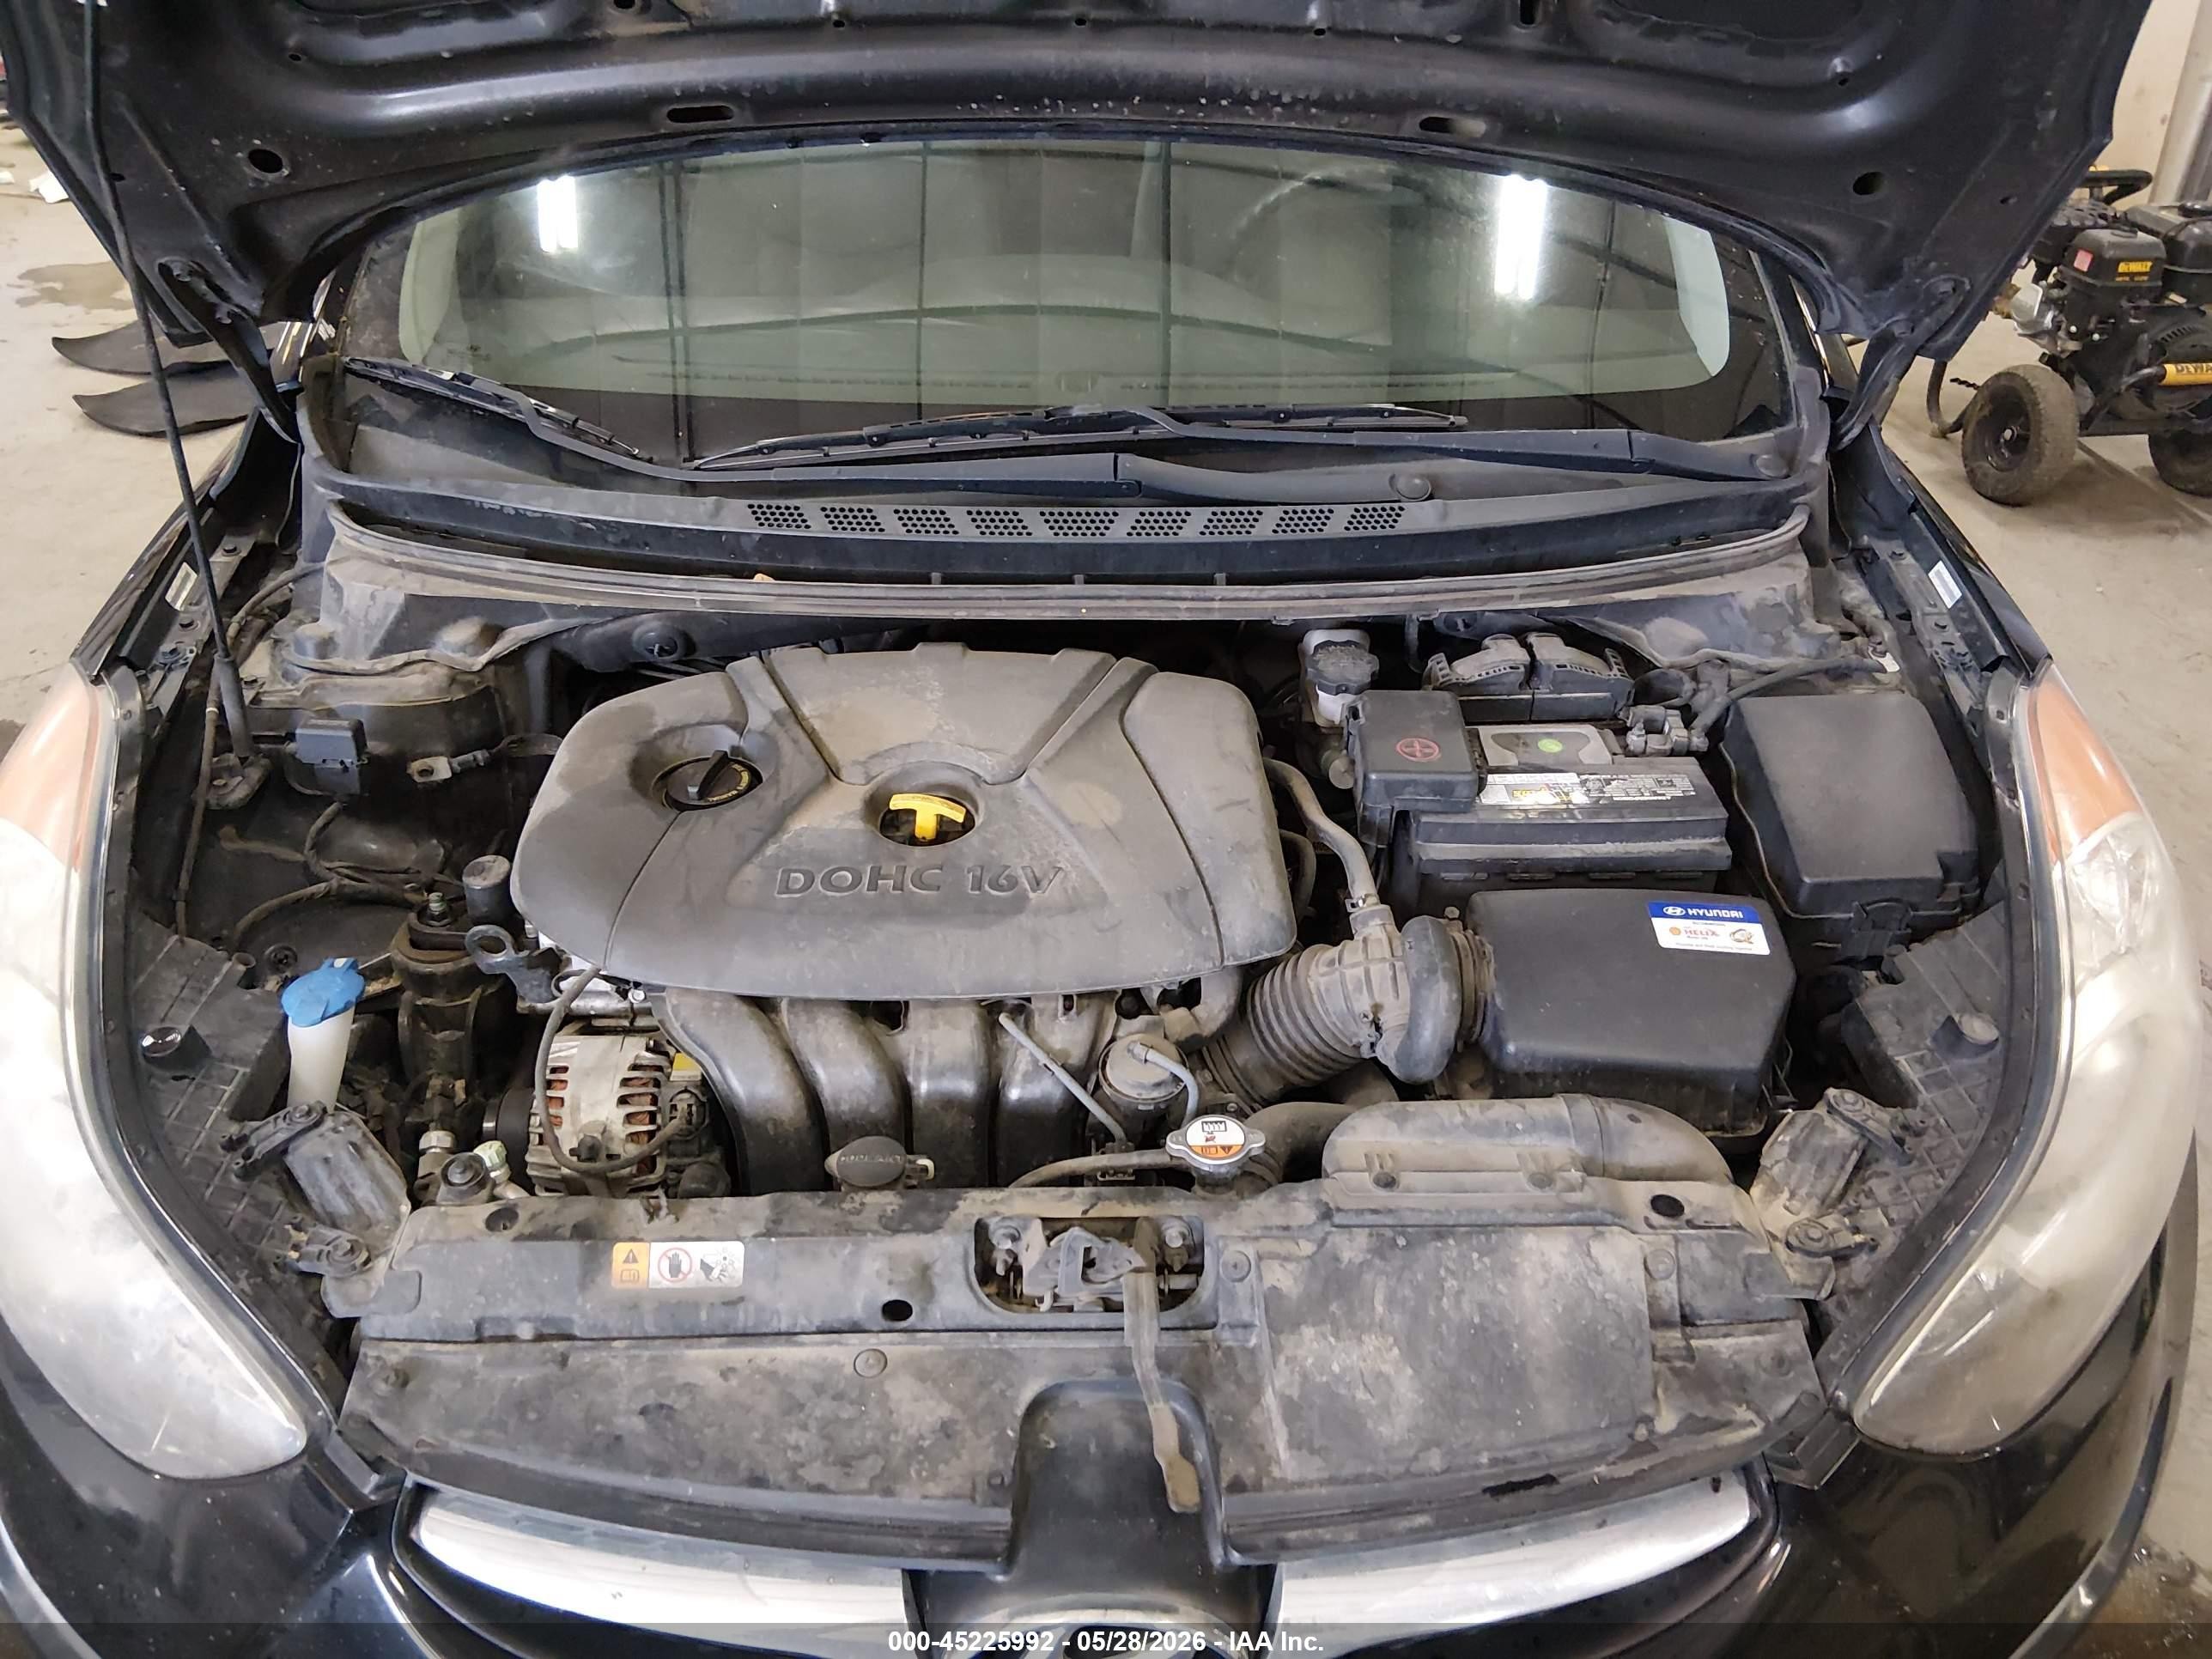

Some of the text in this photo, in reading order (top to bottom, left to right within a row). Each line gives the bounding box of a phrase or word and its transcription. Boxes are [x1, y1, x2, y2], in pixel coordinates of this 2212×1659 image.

[776, 865, 1065, 896] DOHC 16V
[1687, 908, 1744, 919] HYUNDAI
